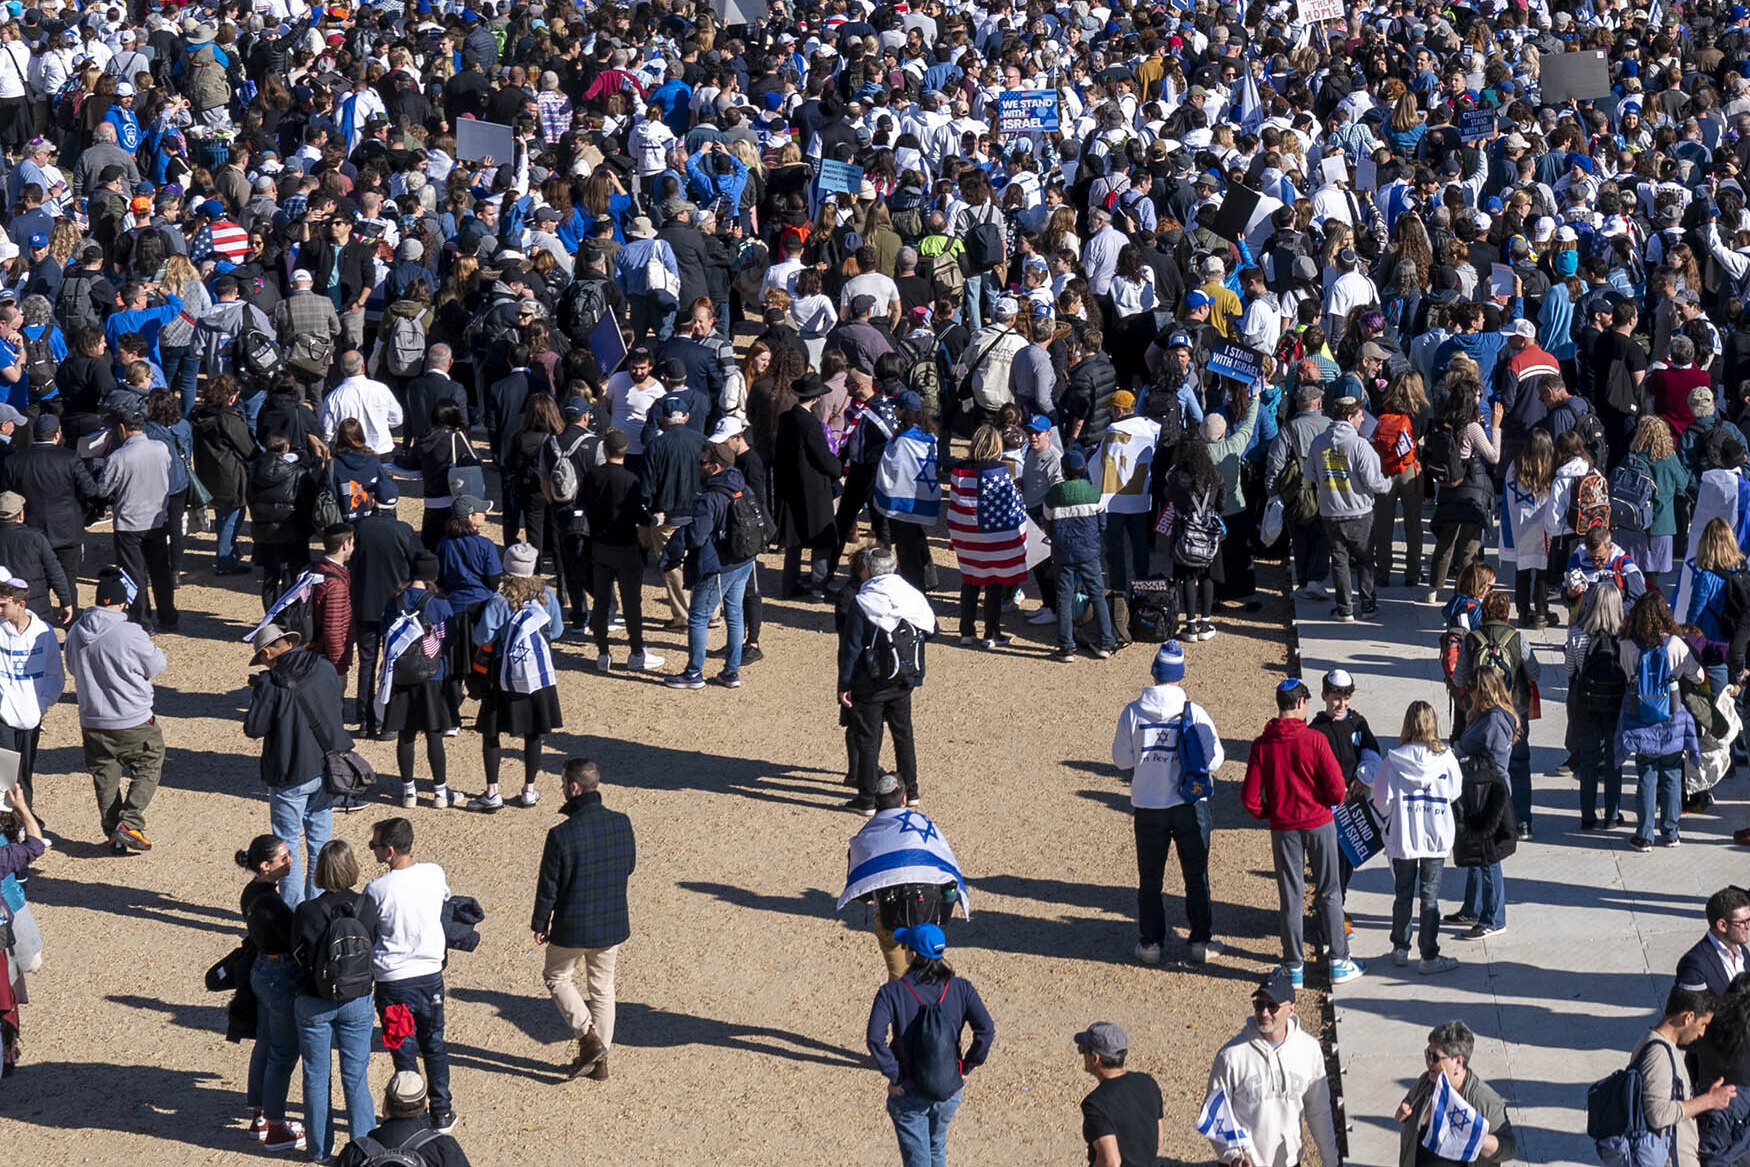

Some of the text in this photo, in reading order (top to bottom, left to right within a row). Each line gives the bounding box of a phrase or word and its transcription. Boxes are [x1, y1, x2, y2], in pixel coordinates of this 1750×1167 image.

[1311, 0, 1335, 9] THEM
[1304, 7, 1341, 22] HOME
[1002, 98, 1053, 109] WE STAND
[1002, 109, 1026, 118] WITH
[1463, 108, 1492, 120] CHRISTIANS
[1003, 117, 1043, 129] ISRAEL
[1470, 116, 1488, 125] STAND
[1463, 124, 1493, 134] WITH ISRAEL
[1224, 344, 1254, 363] I STAND
[1212, 352, 1260, 377] WITH ISRAEL
[1349, 802, 1374, 842] I STAND
[1335, 803, 1369, 860] WITH ISRAEL
[1246, 1071, 1305, 1104] GAP
